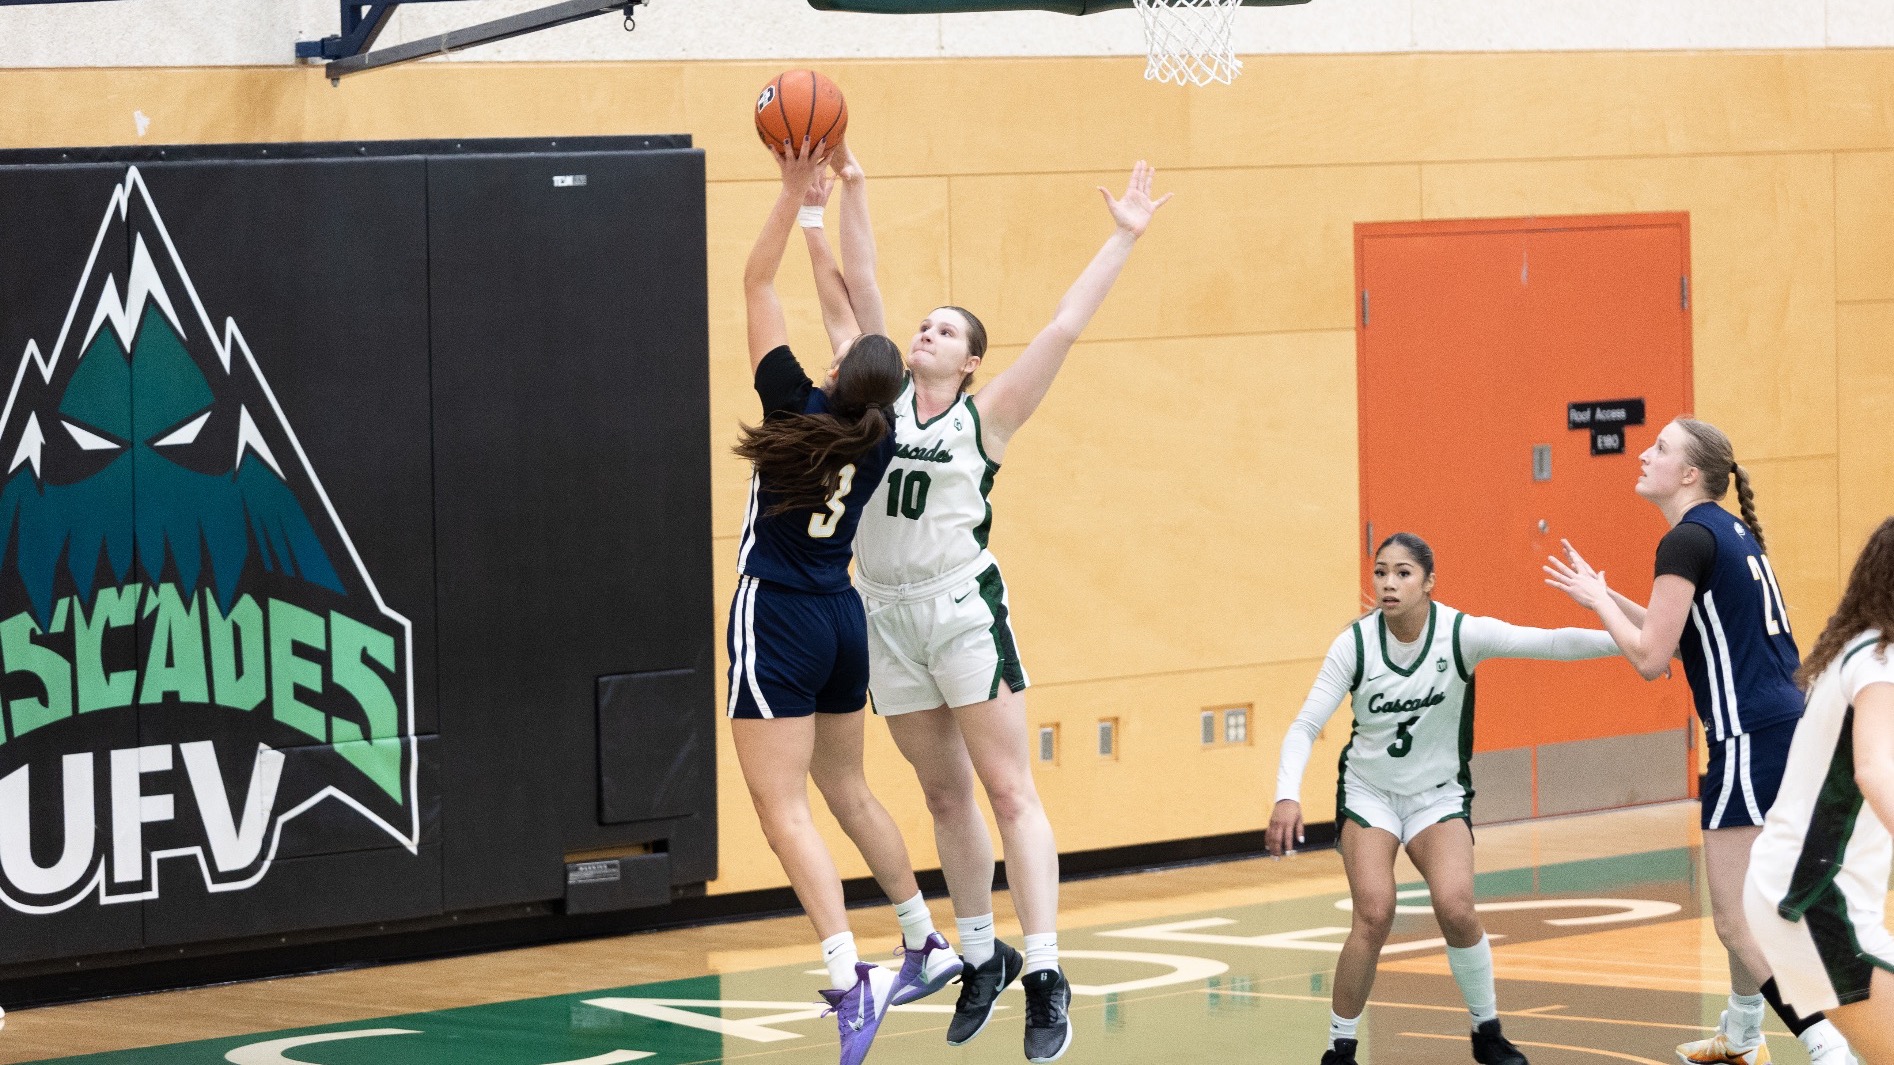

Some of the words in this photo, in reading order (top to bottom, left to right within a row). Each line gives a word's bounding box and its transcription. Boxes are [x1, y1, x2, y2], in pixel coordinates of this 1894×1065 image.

[1595, 406, 1628, 422] Access
[807, 463, 857, 538] 3
[886, 468, 931, 520] 10
[0, 582, 403, 807] SCADES
[1368, 687, 1446, 713] Cascades
[1387, 716, 1420, 757] 5
[0, 740, 286, 895] UFV
